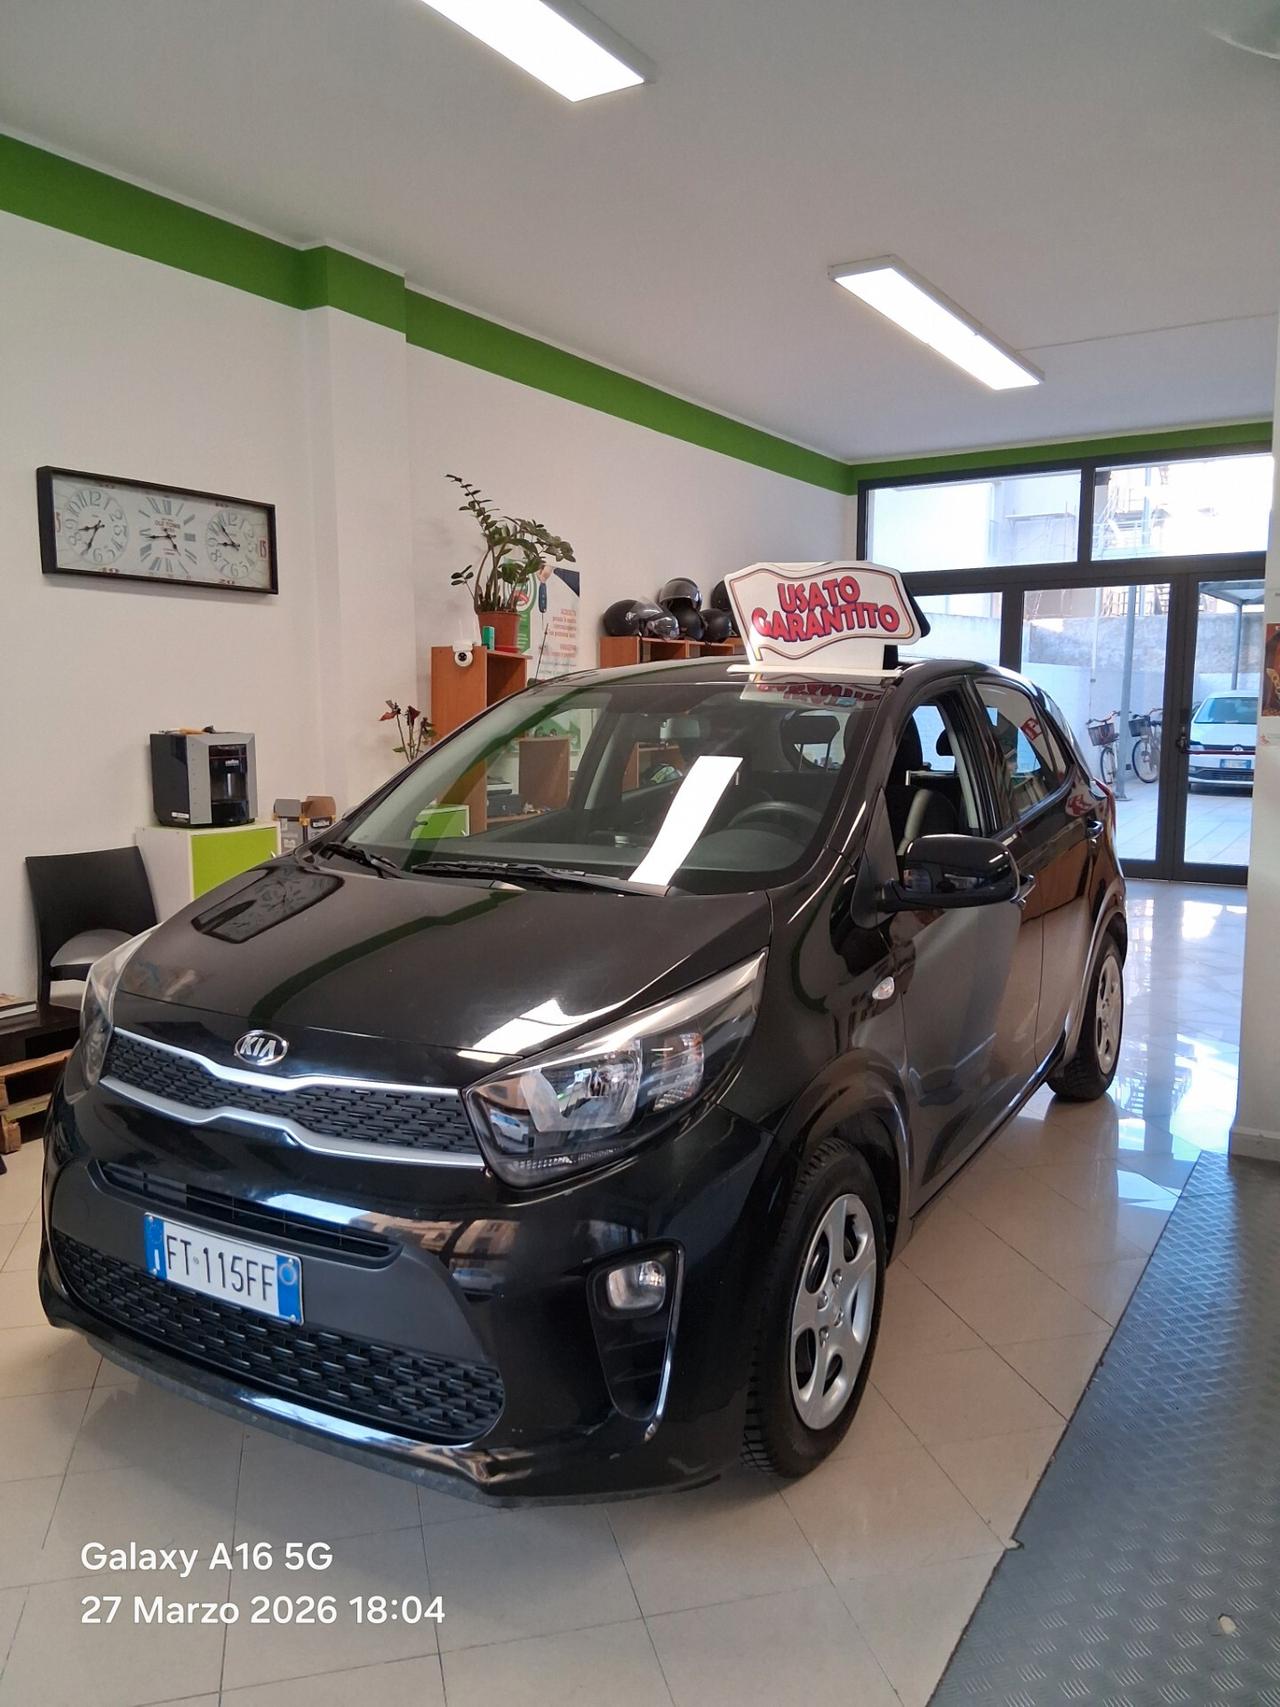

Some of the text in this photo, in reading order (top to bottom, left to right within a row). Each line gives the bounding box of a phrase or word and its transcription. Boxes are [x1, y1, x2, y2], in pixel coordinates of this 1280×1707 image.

[89, 490, 101, 506] 12
[93, 547, 104, 562] 6
[776, 576, 861, 613] USATO
[752, 602, 900, 642] GARANTITO
[240, 1036, 277, 1059] KIA
[166, 1235, 191, 1276] FT
[203, 1247, 275, 1301] 115FF
